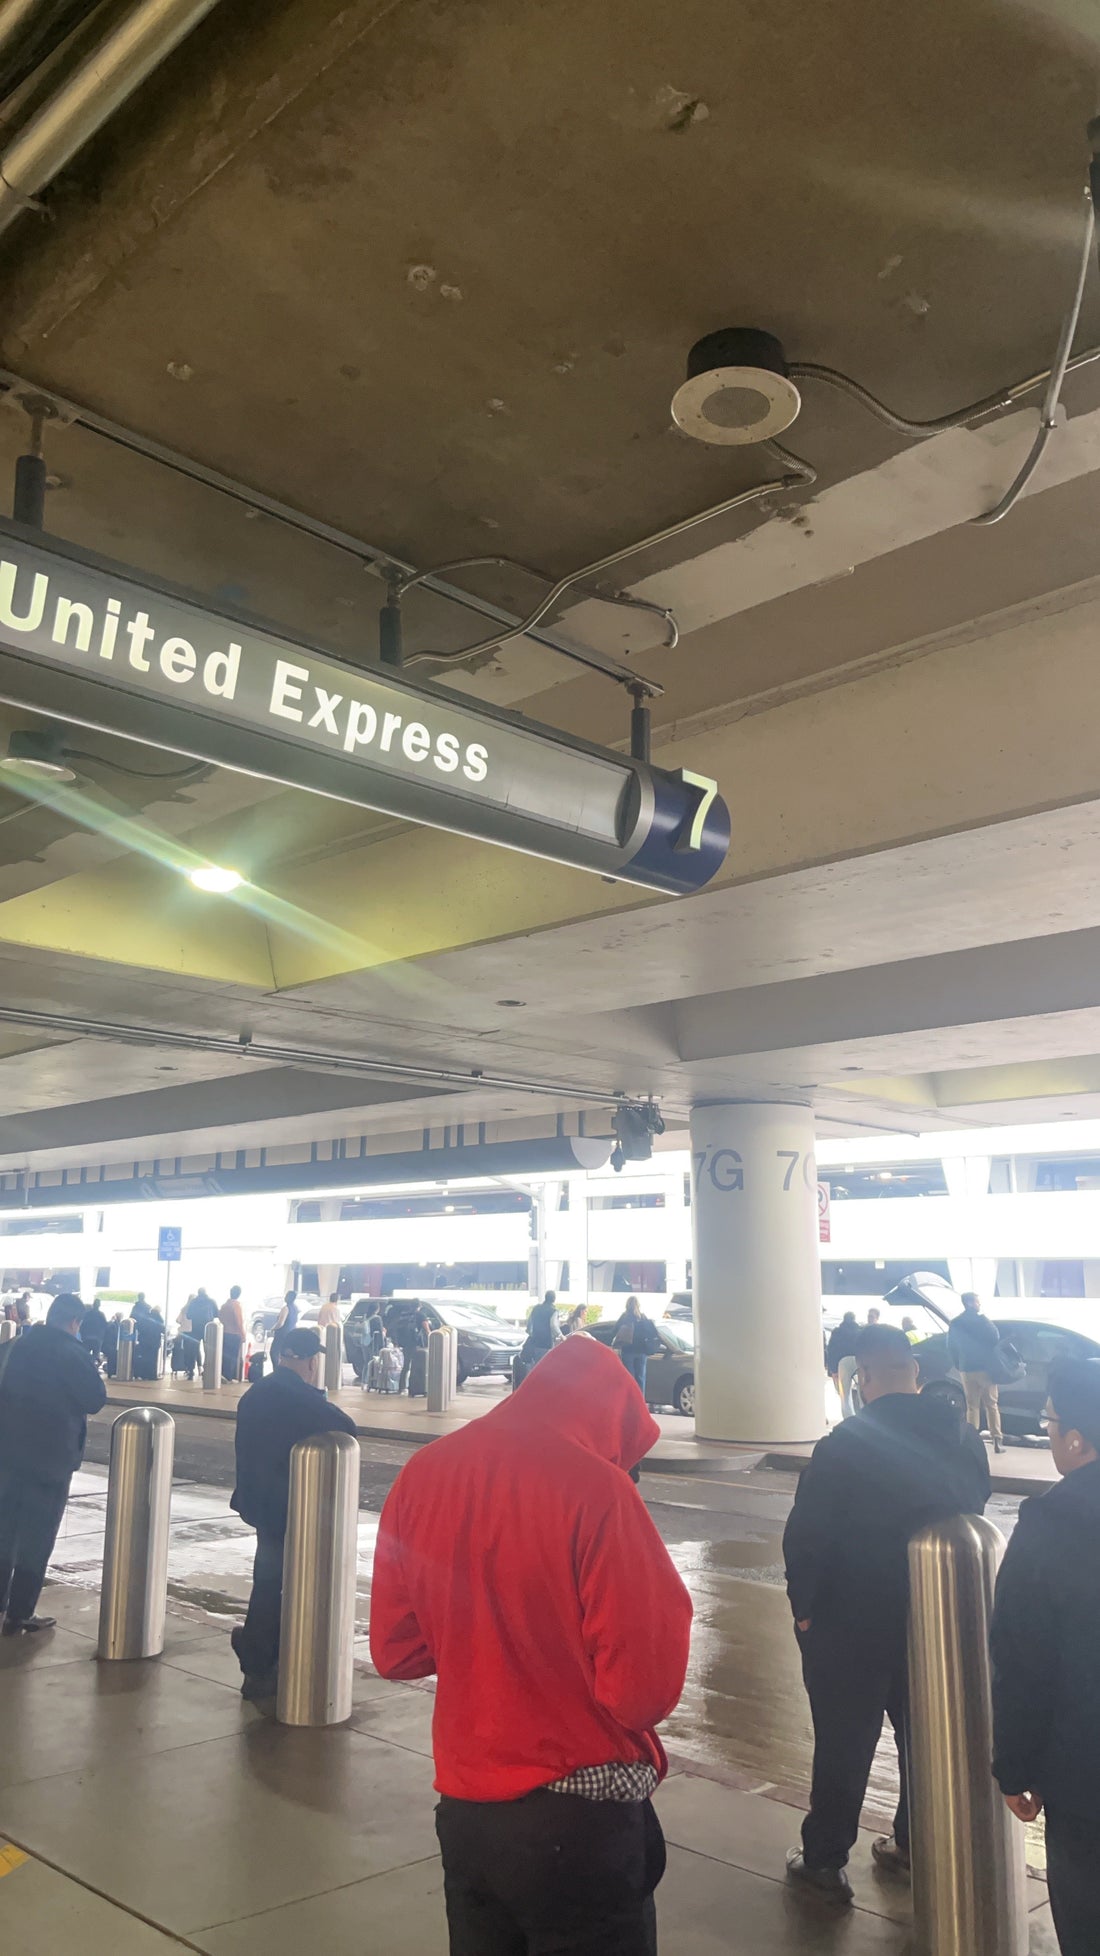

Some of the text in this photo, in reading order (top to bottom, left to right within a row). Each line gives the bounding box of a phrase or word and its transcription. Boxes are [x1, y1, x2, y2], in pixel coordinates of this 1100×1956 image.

[0, 560, 489, 782] United Express
[682, 768, 718, 850] 7
[693, 1149, 744, 1192] 7G
